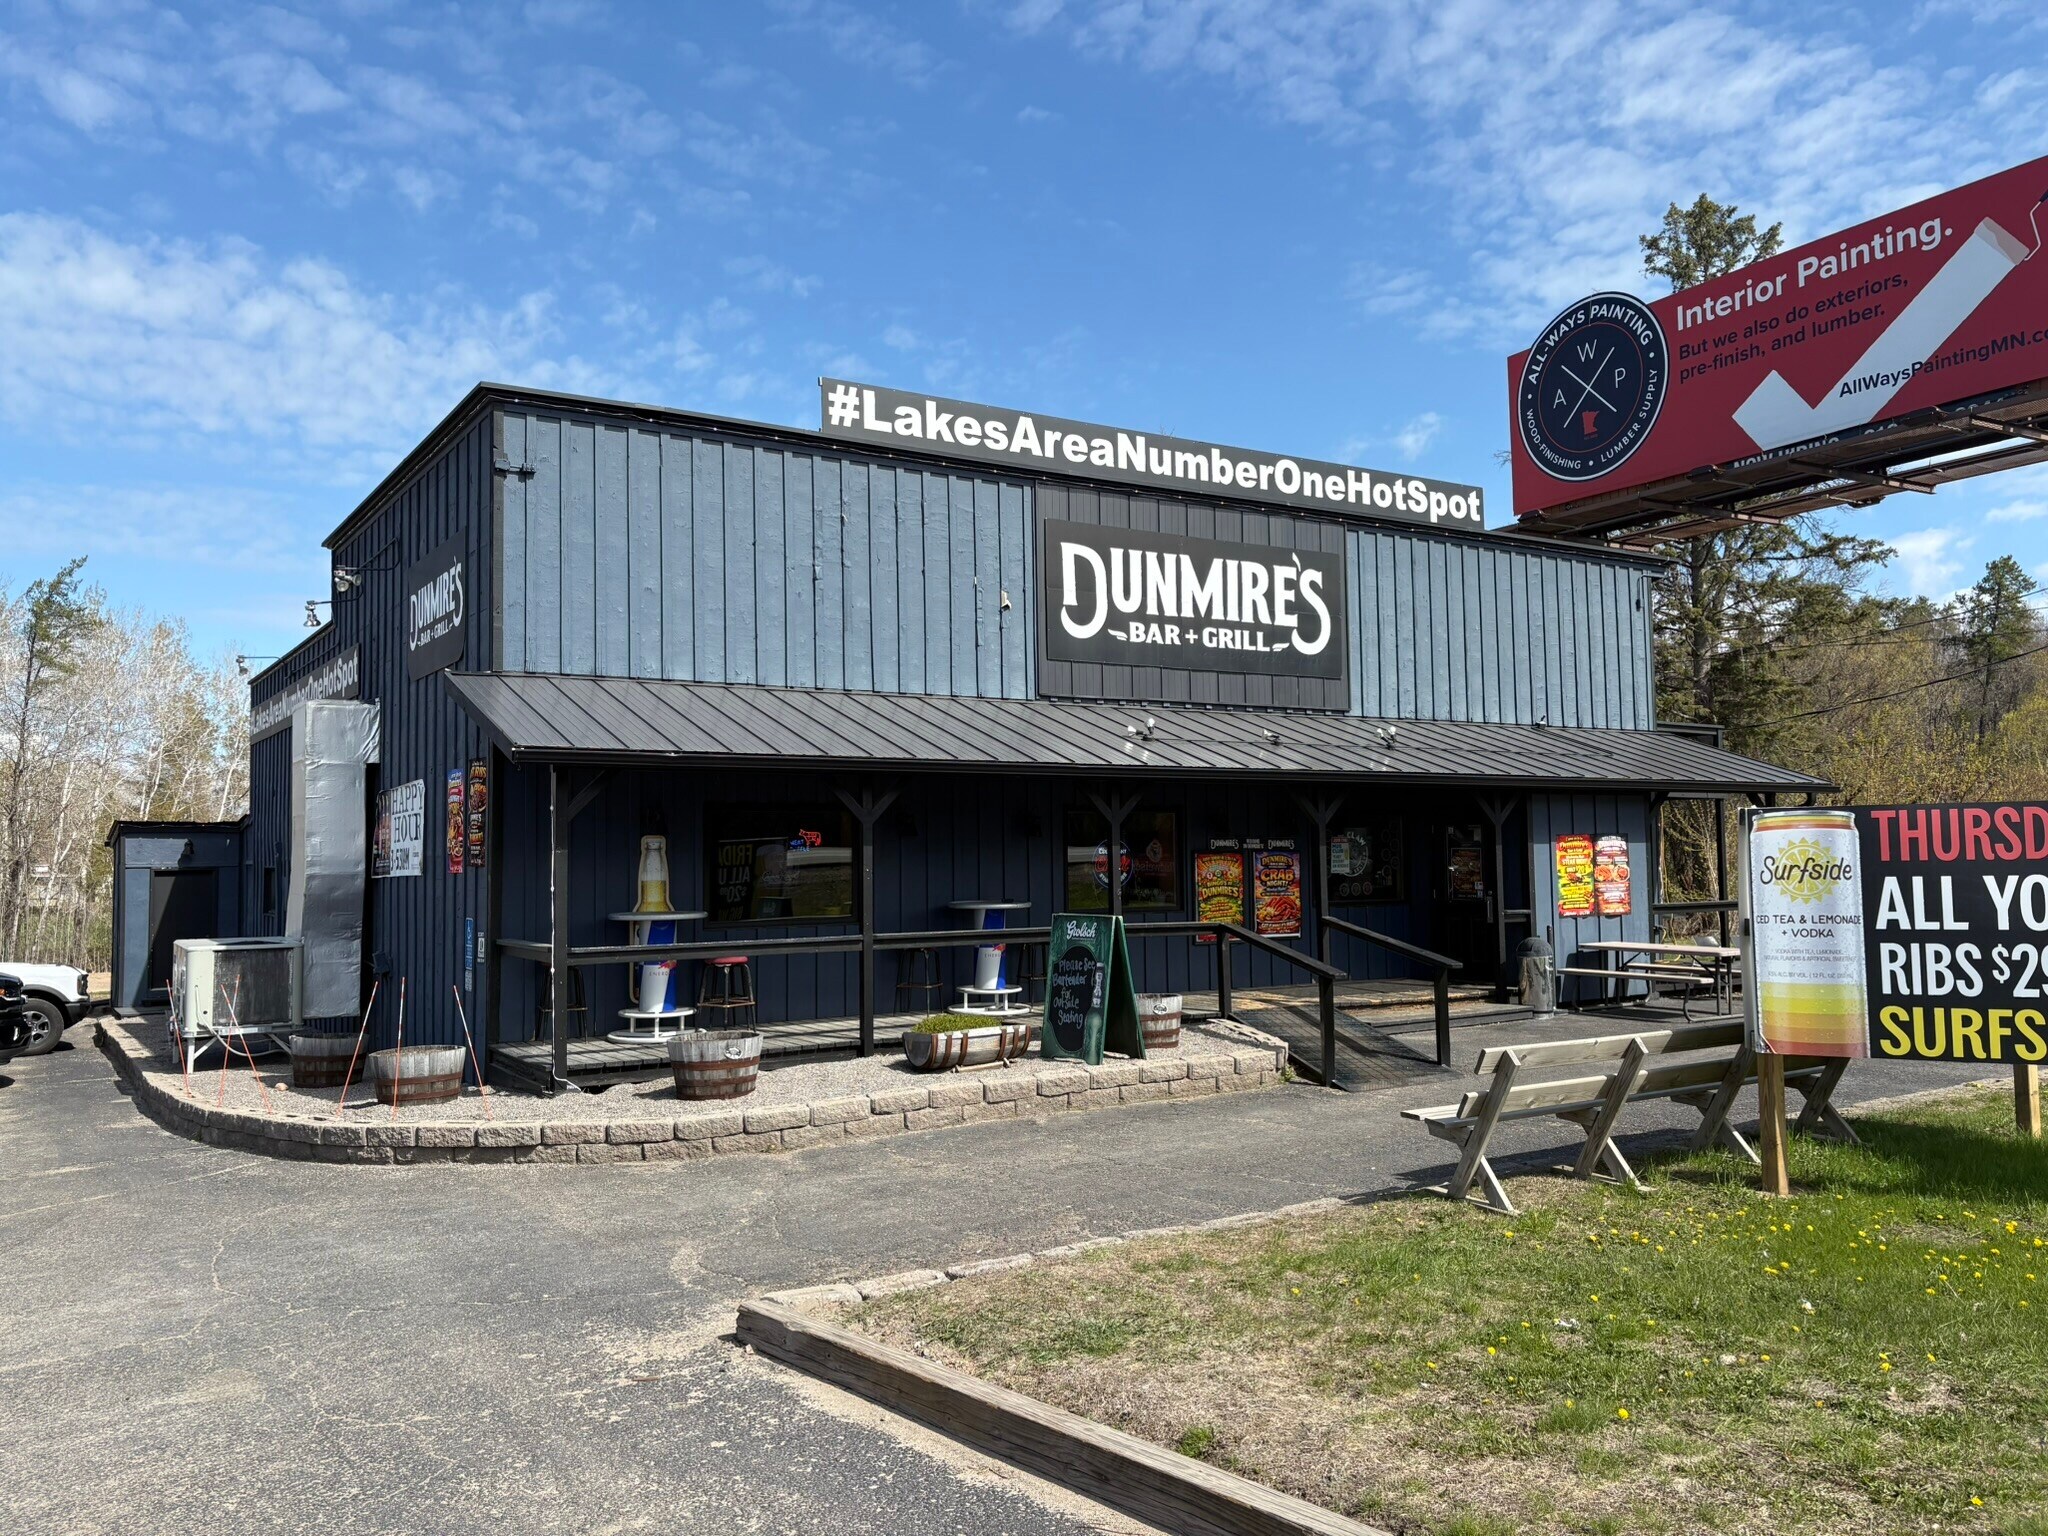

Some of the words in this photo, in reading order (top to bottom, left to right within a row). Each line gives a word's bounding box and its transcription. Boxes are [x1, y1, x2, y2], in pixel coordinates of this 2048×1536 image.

[1677, 273, 1787, 331] Interior
[1797, 217, 1953, 288] Painting.
[1679, 338, 1708, 360] But
[1713, 331, 1738, 348] we
[1744, 317, 1779, 339] also
[1785, 306, 1809, 323] do
[1815, 273, 1908, 314] exteriors,
[1528, 309, 1586, 385] ALL-WAYS
[1590, 303, 1654, 346] PAINTING
[1577, 339, 1597, 362] W
[1680, 343, 1765, 384] pre-finish,
[1771, 327, 1806, 351] and
[1812, 303, 1886, 337] lumber.
[1614, 367, 1626, 389] P
[1553, 388, 1567, 409] A
[1600, 422, 1641, 463] LUMBER
[1639, 369, 1658, 420] SUPPLY
[827, 383, 1482, 523] #LakesAreaNumberOneHotSpot
[1526, 408, 1582, 469] WOOD-FINISHING
[409, 555, 463, 651] DUNMIRE'S
[1060, 541, 1331, 655] DUNMIRE'S
[420, 628, 431, 646] BAR
[434, 618, 449, 639] GRILL
[1129, 621, 1181, 646] BAR
[1185, 629, 1198, 644] +
[1202, 627, 1270, 652] GRILL
[391, 782, 424, 815] HAPPY
[394, 813, 422, 843] HOUR
[1260, 869, 1295, 882] CRAB
[1760, 855, 1853, 885] Surfside
[1875, 876, 1969, 930] ALL
[1982, 874, 2048, 931] YO
[1066, 920, 1097, 940] Grolsch
[1773, 914, 1795, 924] TEA
[1799, 914, 1807, 924] &
[1811, 914, 1861, 925] LEMONADE
[1791, 928, 1835, 938] VODKA
[1052, 972, 1087, 987] Bartender
[1059, 959, 1083, 973] Please
[1083, 957, 1096, 971] See
[1879, 942, 1984, 997] RIBS
[1061, 987, 1072, 999] for
[1058, 1009, 1084, 1030] Seating
[1879, 1005, 2048, 1061] SURFS
